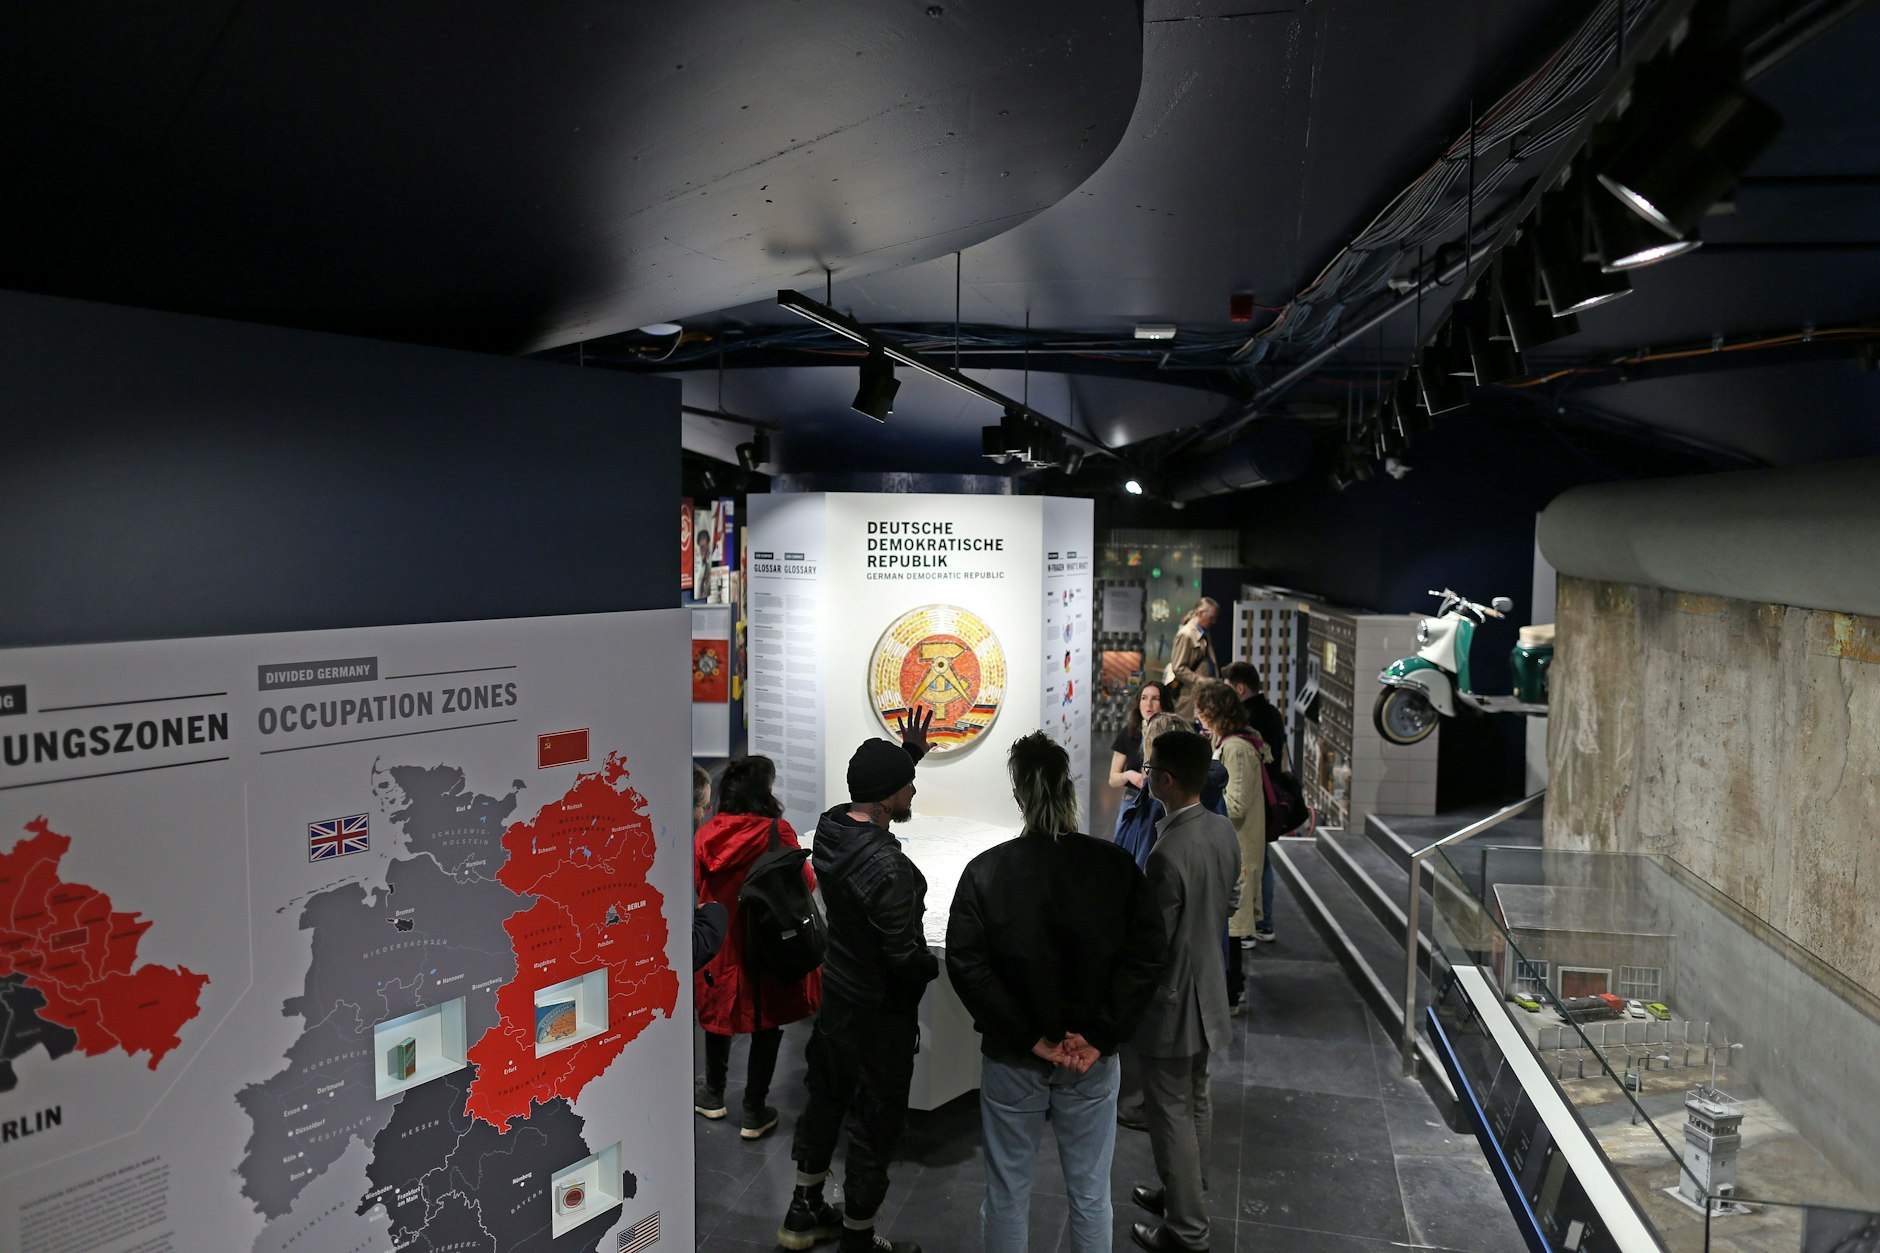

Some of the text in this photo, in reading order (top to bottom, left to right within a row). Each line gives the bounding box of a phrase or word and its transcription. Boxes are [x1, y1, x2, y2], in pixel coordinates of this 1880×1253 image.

[867, 521, 953, 535] DEUTSCHE
[867, 538, 1004, 551] DEMOKRATISCHE
[867, 555, 948, 568] REPUBLIK
[754, 564, 781, 573] GLOSSAR
[784, 565, 817, 574] GLOSSARY
[866, 571, 1005, 580] GERMAN DEMOCRATIC REPUBLIC
[266, 664, 371, 684] DIVIDED GERMANY
[258, 682, 518, 735] OCCUPATION ZONES
[4, 712, 229, 767] UNGSZONEN
[432, 828, 490, 839] SCHLESWIG-
[465, 859, 486, 868] Hamburg
[395, 907, 415, 916] Bremen
[627, 900, 646, 911] BERLIN
[362, 939, 448, 959] NIEDERSACHSEN
[533, 958, 556, 969] Magdeburg
[442, 973, 464, 984] Hannover
[472, 976, 503, 991] Braunschweig
[632, 1007, 647, 1016] Dresden
[603, 1034, 621, 1044] Chemnitz
[503, 1066, 517, 1075] Erfurt
[317, 1080, 345, 1095] Dortmund
[284, 1107, 301, 1118] Essen
[0, 1105, 62, 1144] RLIN
[295, 1118, 326, 1135] Düsseldorf
[309, 1115, 372, 1144] WESTFALEN
[401, 1119, 440, 1138] HESSEN
[283, 1154, 296, 1164] Köln
[290, 1171, 306, 1181] Bonn
[365, 1184, 392, 1200] Wiesbaden
[397, 1186, 420, 1201] Frankfurt
[405, 1194, 418, 1204] Main
[510, 1189, 543, 1214] BAYERN
